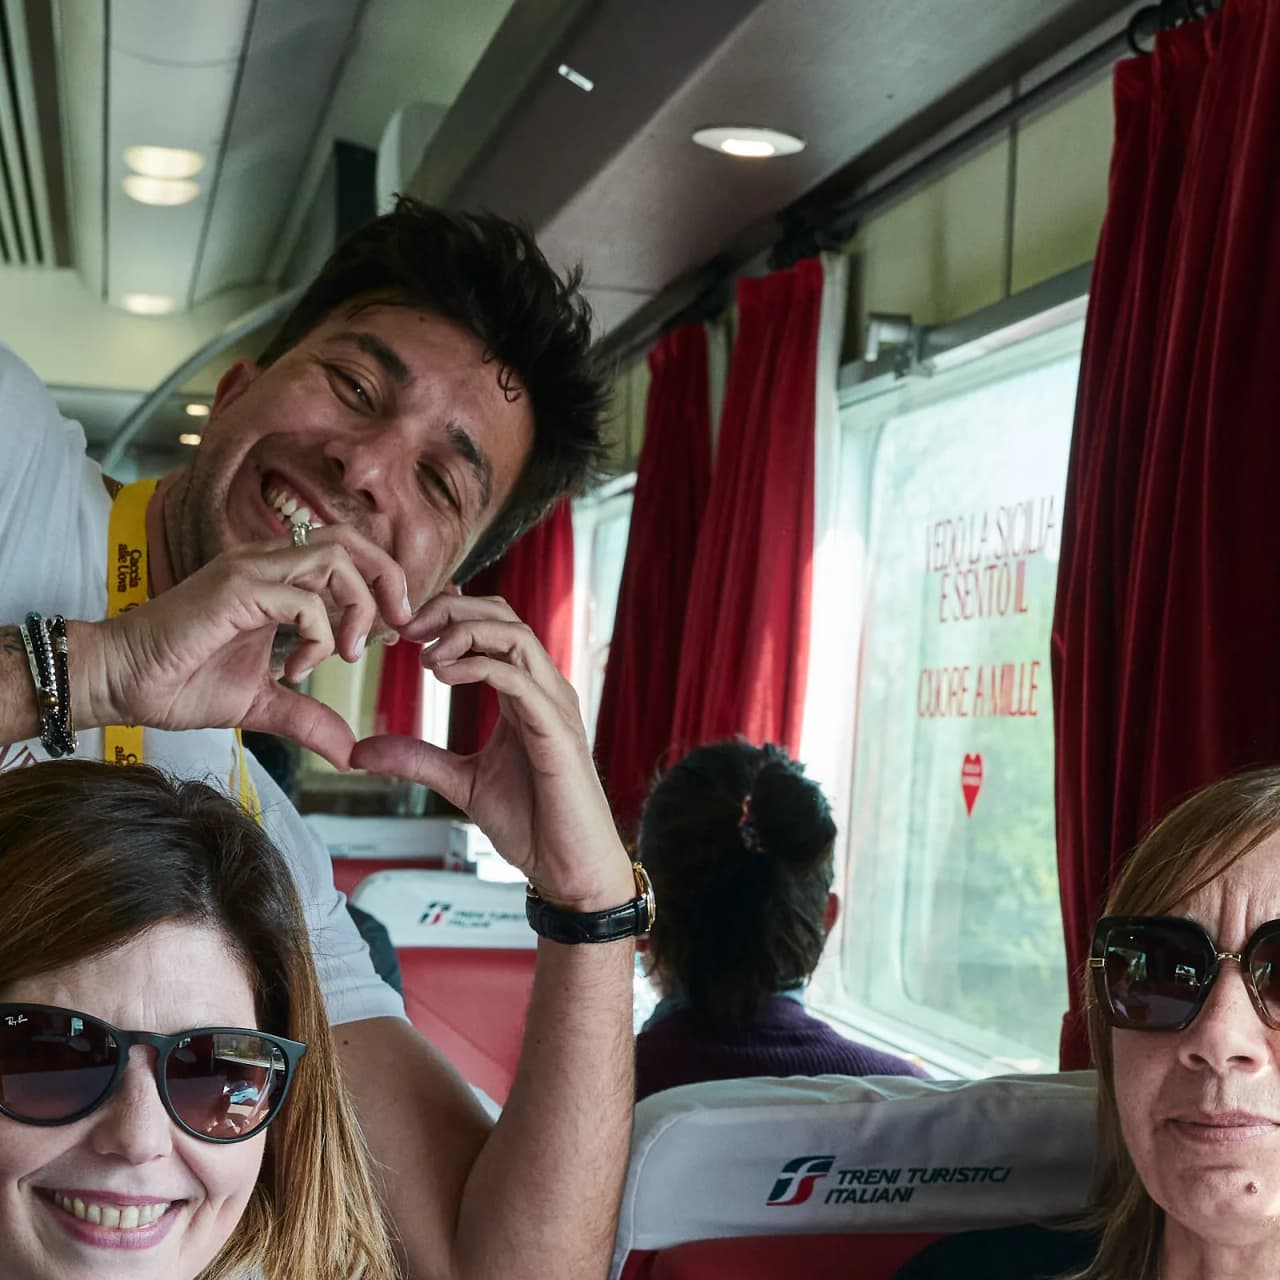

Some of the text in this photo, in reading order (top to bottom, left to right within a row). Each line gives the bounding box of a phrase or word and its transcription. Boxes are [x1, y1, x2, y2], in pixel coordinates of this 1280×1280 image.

[837, 1166, 1013, 1186] TRENI TURISTICI
[824, 1186, 915, 1205] ITALIANI
